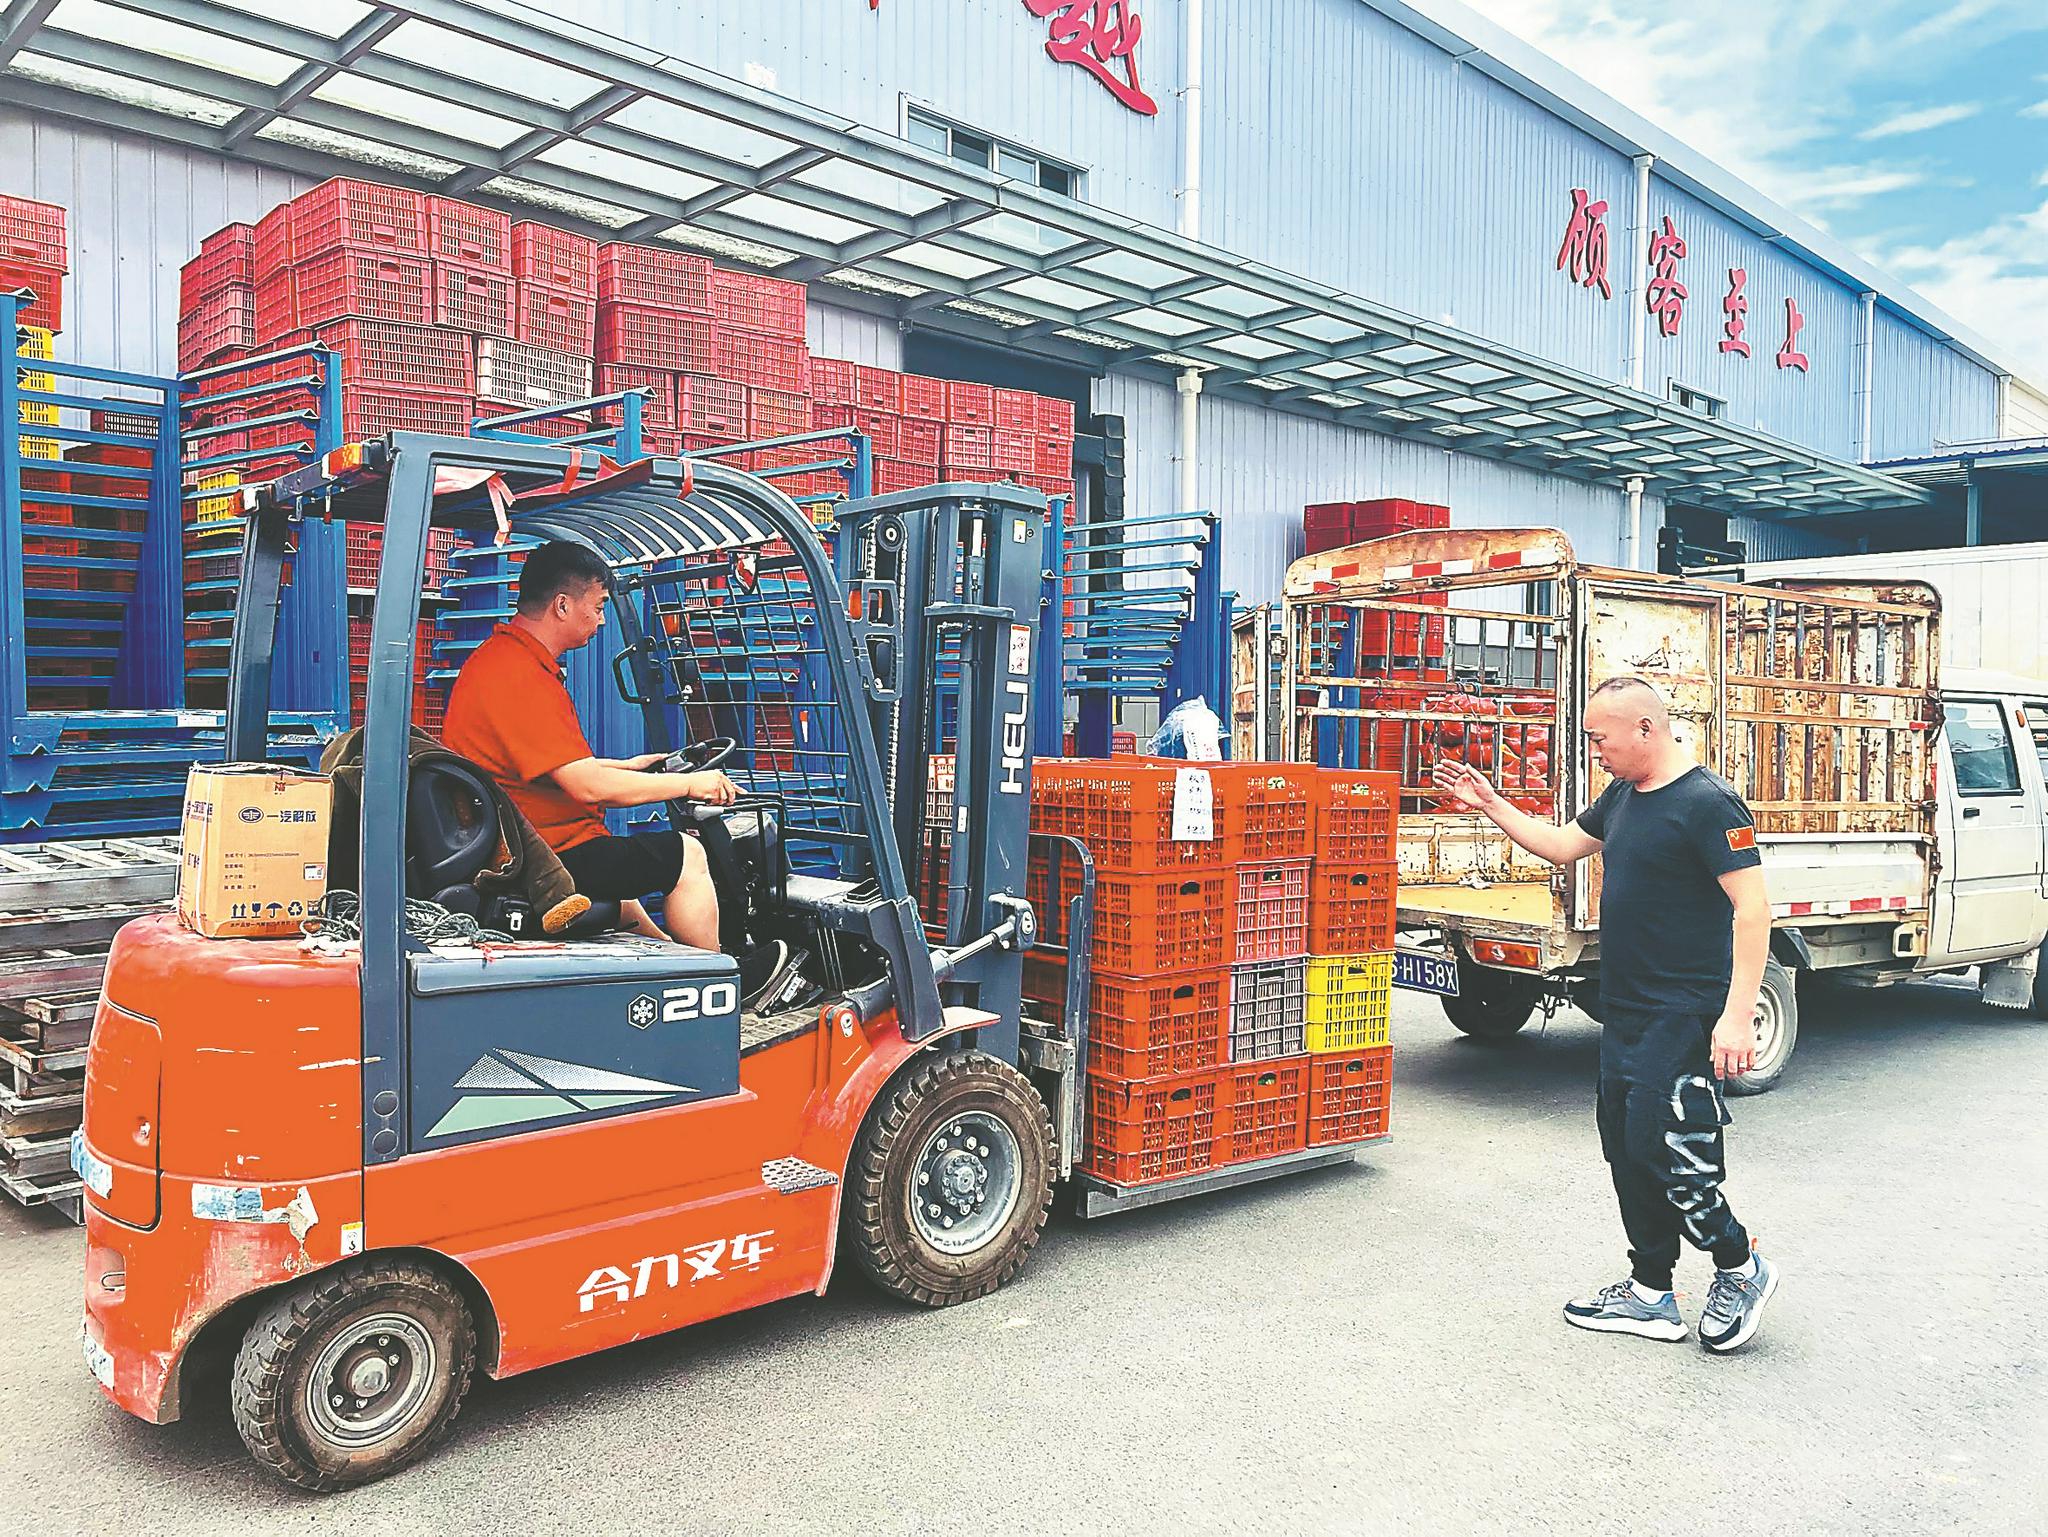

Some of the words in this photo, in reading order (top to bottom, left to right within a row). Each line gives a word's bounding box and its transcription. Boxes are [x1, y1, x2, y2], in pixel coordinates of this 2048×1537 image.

[1557, 187, 1809, 372] 顾客至上
[1000, 681, 1029, 794] HELI
[266, 810, 316, 823] 一汽解放
[662, 982, 736, 1022] 20
[576, 1229, 774, 1313] 合力叉车
